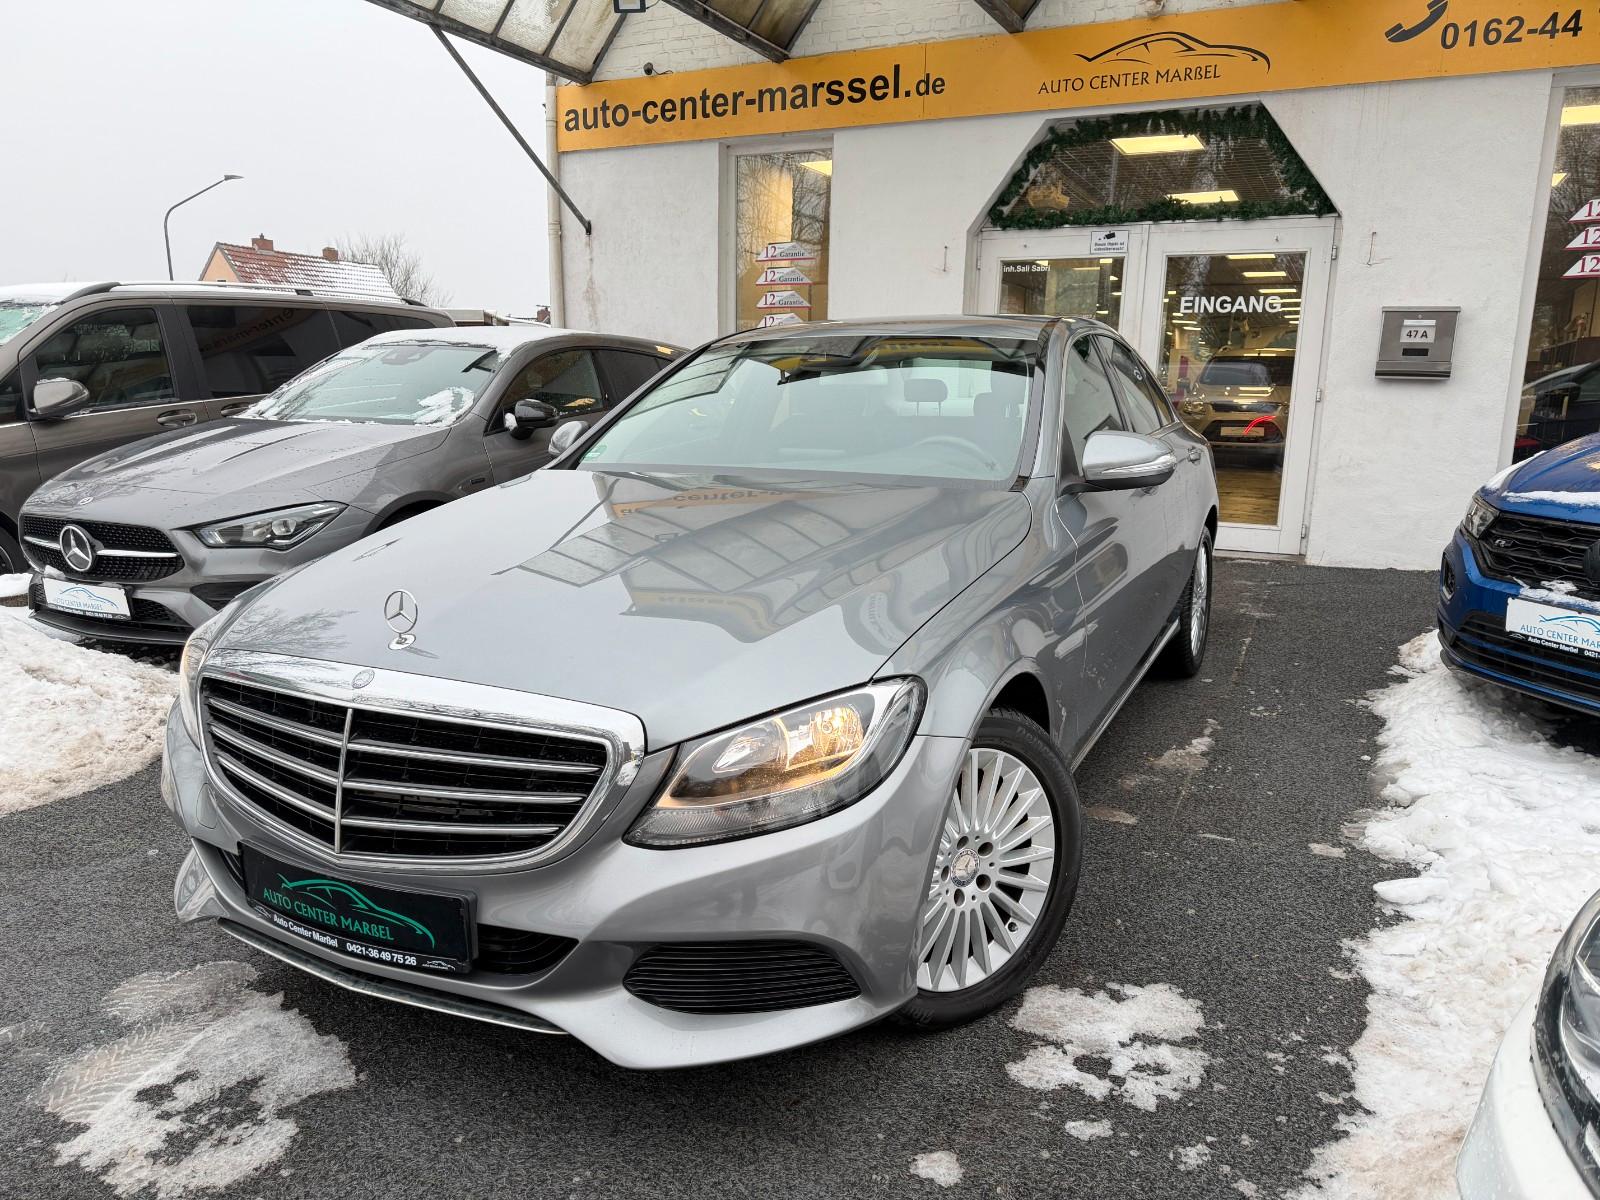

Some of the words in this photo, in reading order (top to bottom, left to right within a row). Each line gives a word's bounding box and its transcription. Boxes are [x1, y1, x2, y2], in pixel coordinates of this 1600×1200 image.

[1441, 9, 1583, 50] 0162-44
[1038, 77, 1085, 95] AUTO
[1089, 71, 1150, 90] CENTER
[564, 63, 946, 133] auto-center-marssel.de
[764, 245, 777, 259] 12
[1577, 256, 1600, 273] 12
[763, 270, 776, 282] 12
[763, 293, 776, 306] 12
[1180, 295, 1282, 314] EINGANG
[1520, 623, 1544, 636] AUTO
[1546, 629, 1579, 644] CENTER
[1528, 636, 1541, 644] Auto
[263, 887, 291, 910] AUTO
[294, 901, 339, 927] CENTER
[273, 913, 288, 928] Auto
[288, 921, 312, 938] Center
[346, 942, 379, 959] 0421-36
[380, 951, 391, 961] 49
[391, 953, 404, 964] 75
[404, 955, 417, 966] 26
